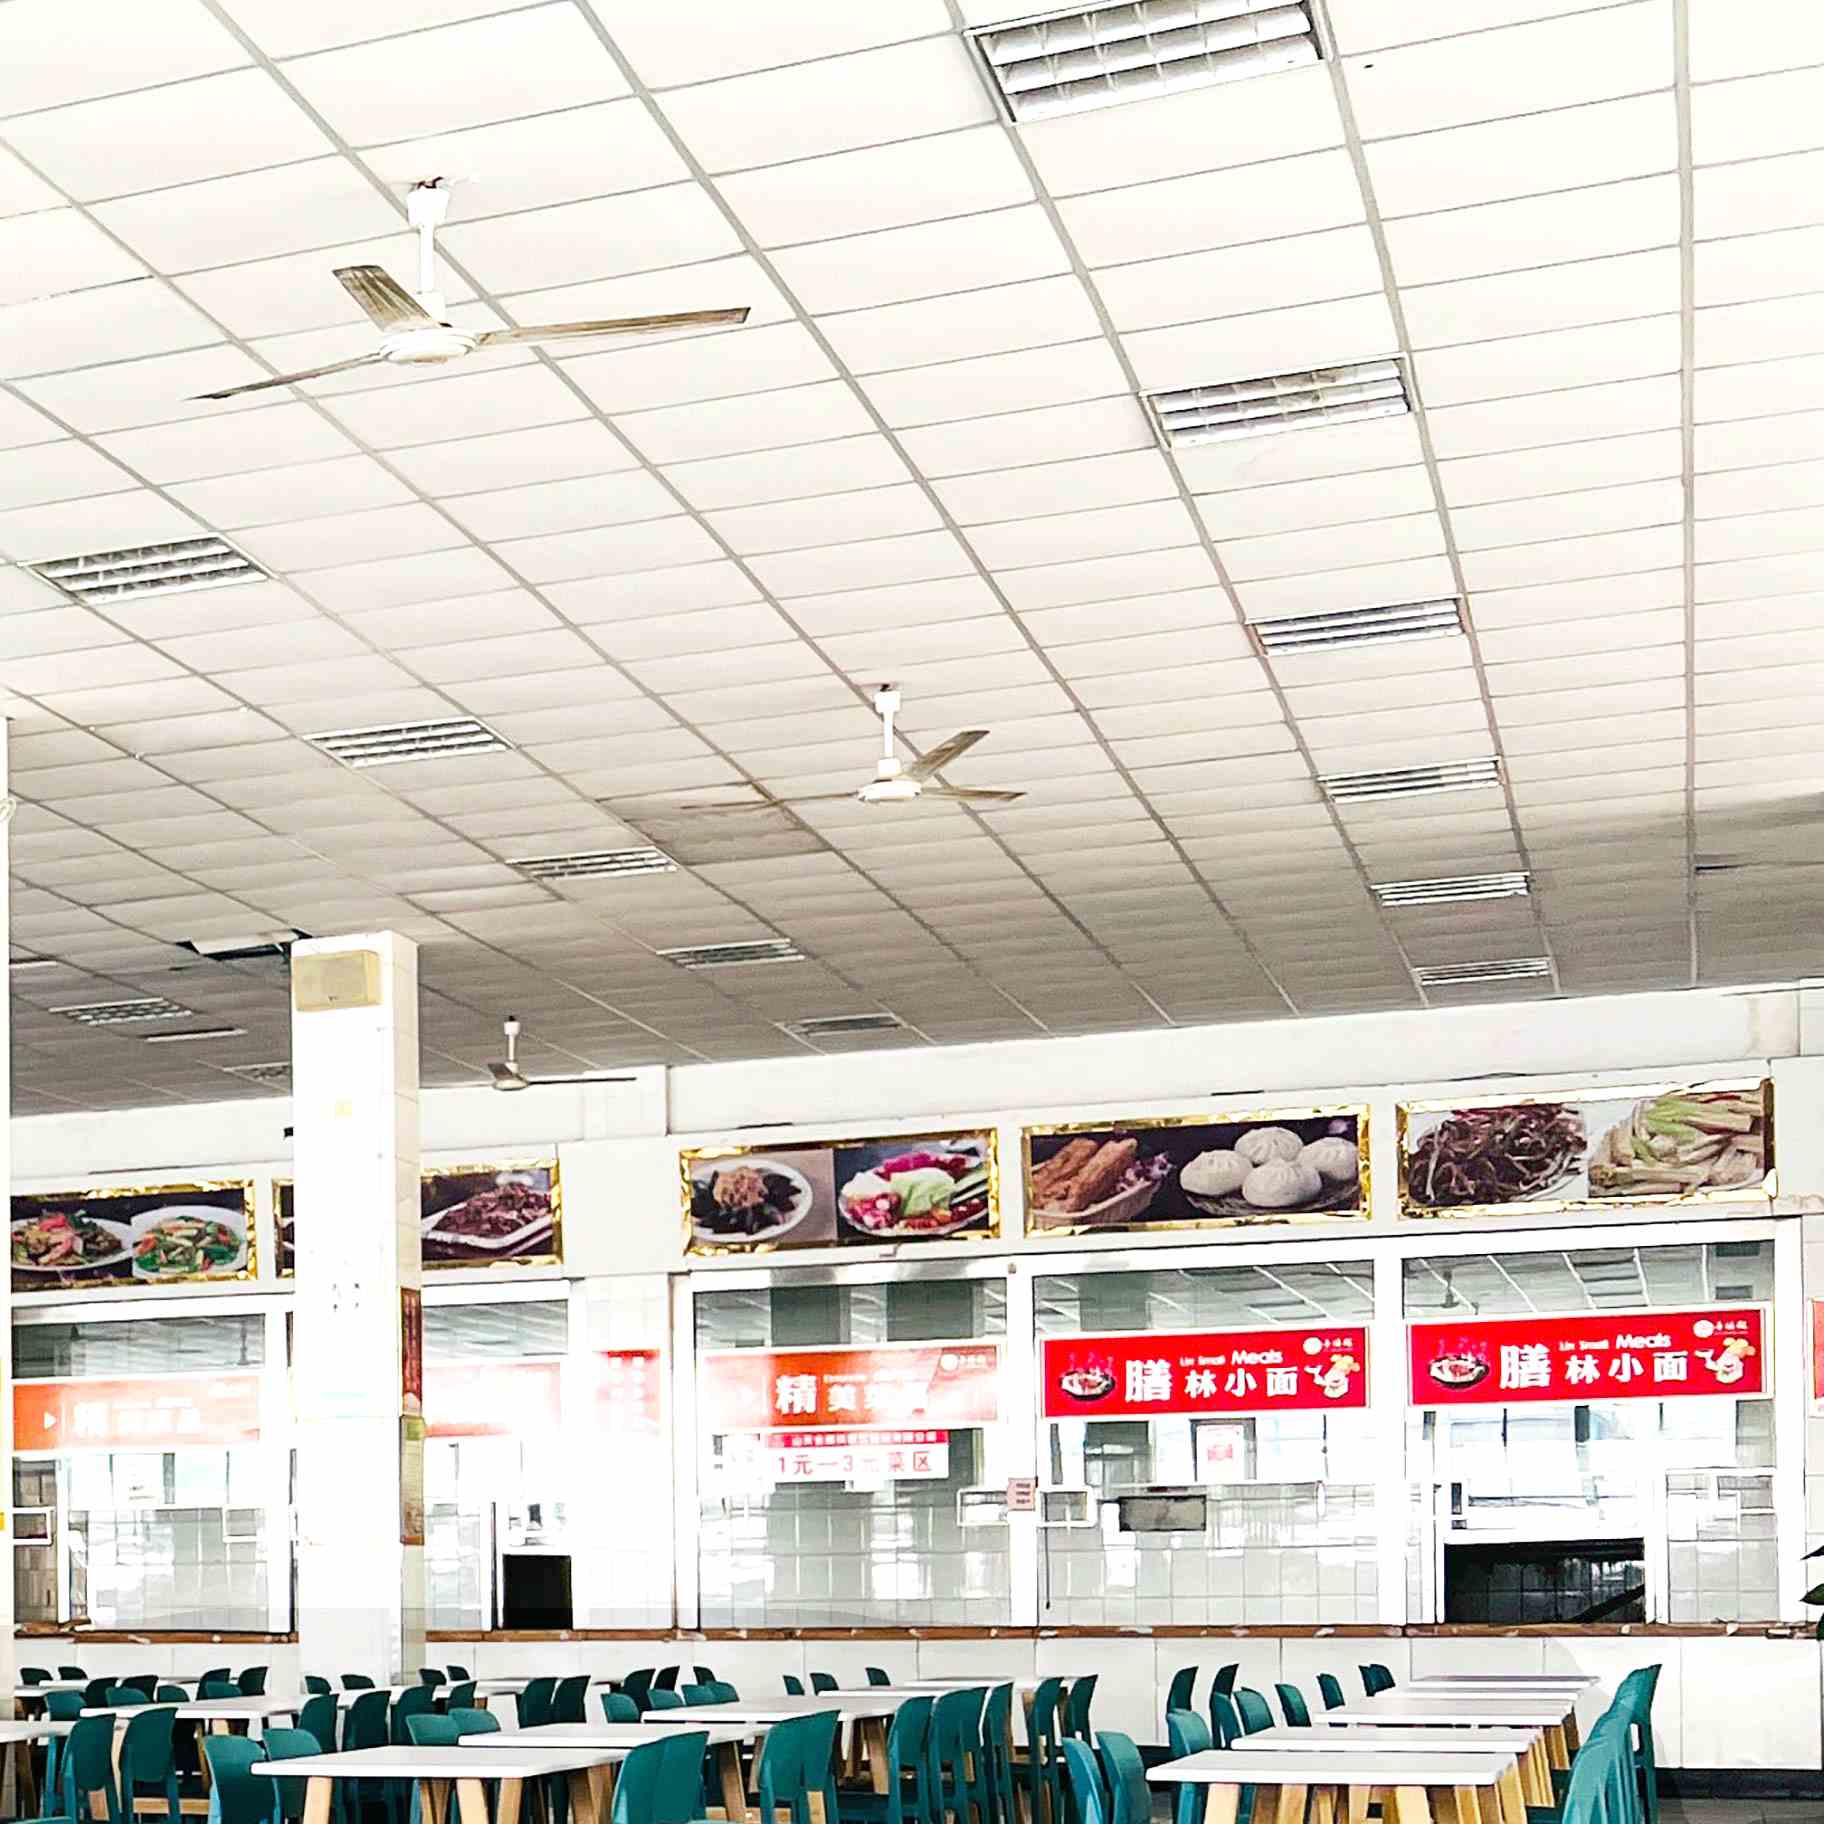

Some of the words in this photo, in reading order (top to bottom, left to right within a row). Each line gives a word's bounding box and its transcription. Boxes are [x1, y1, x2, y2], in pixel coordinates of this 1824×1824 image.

[1616, 1333, 1672, 1349] Meals
[1231, 1350, 1283, 1365] Meals
[1500, 1344, 1688, 1389] 膳林小面
[1125, 1358, 1298, 1402] 膳林小面
